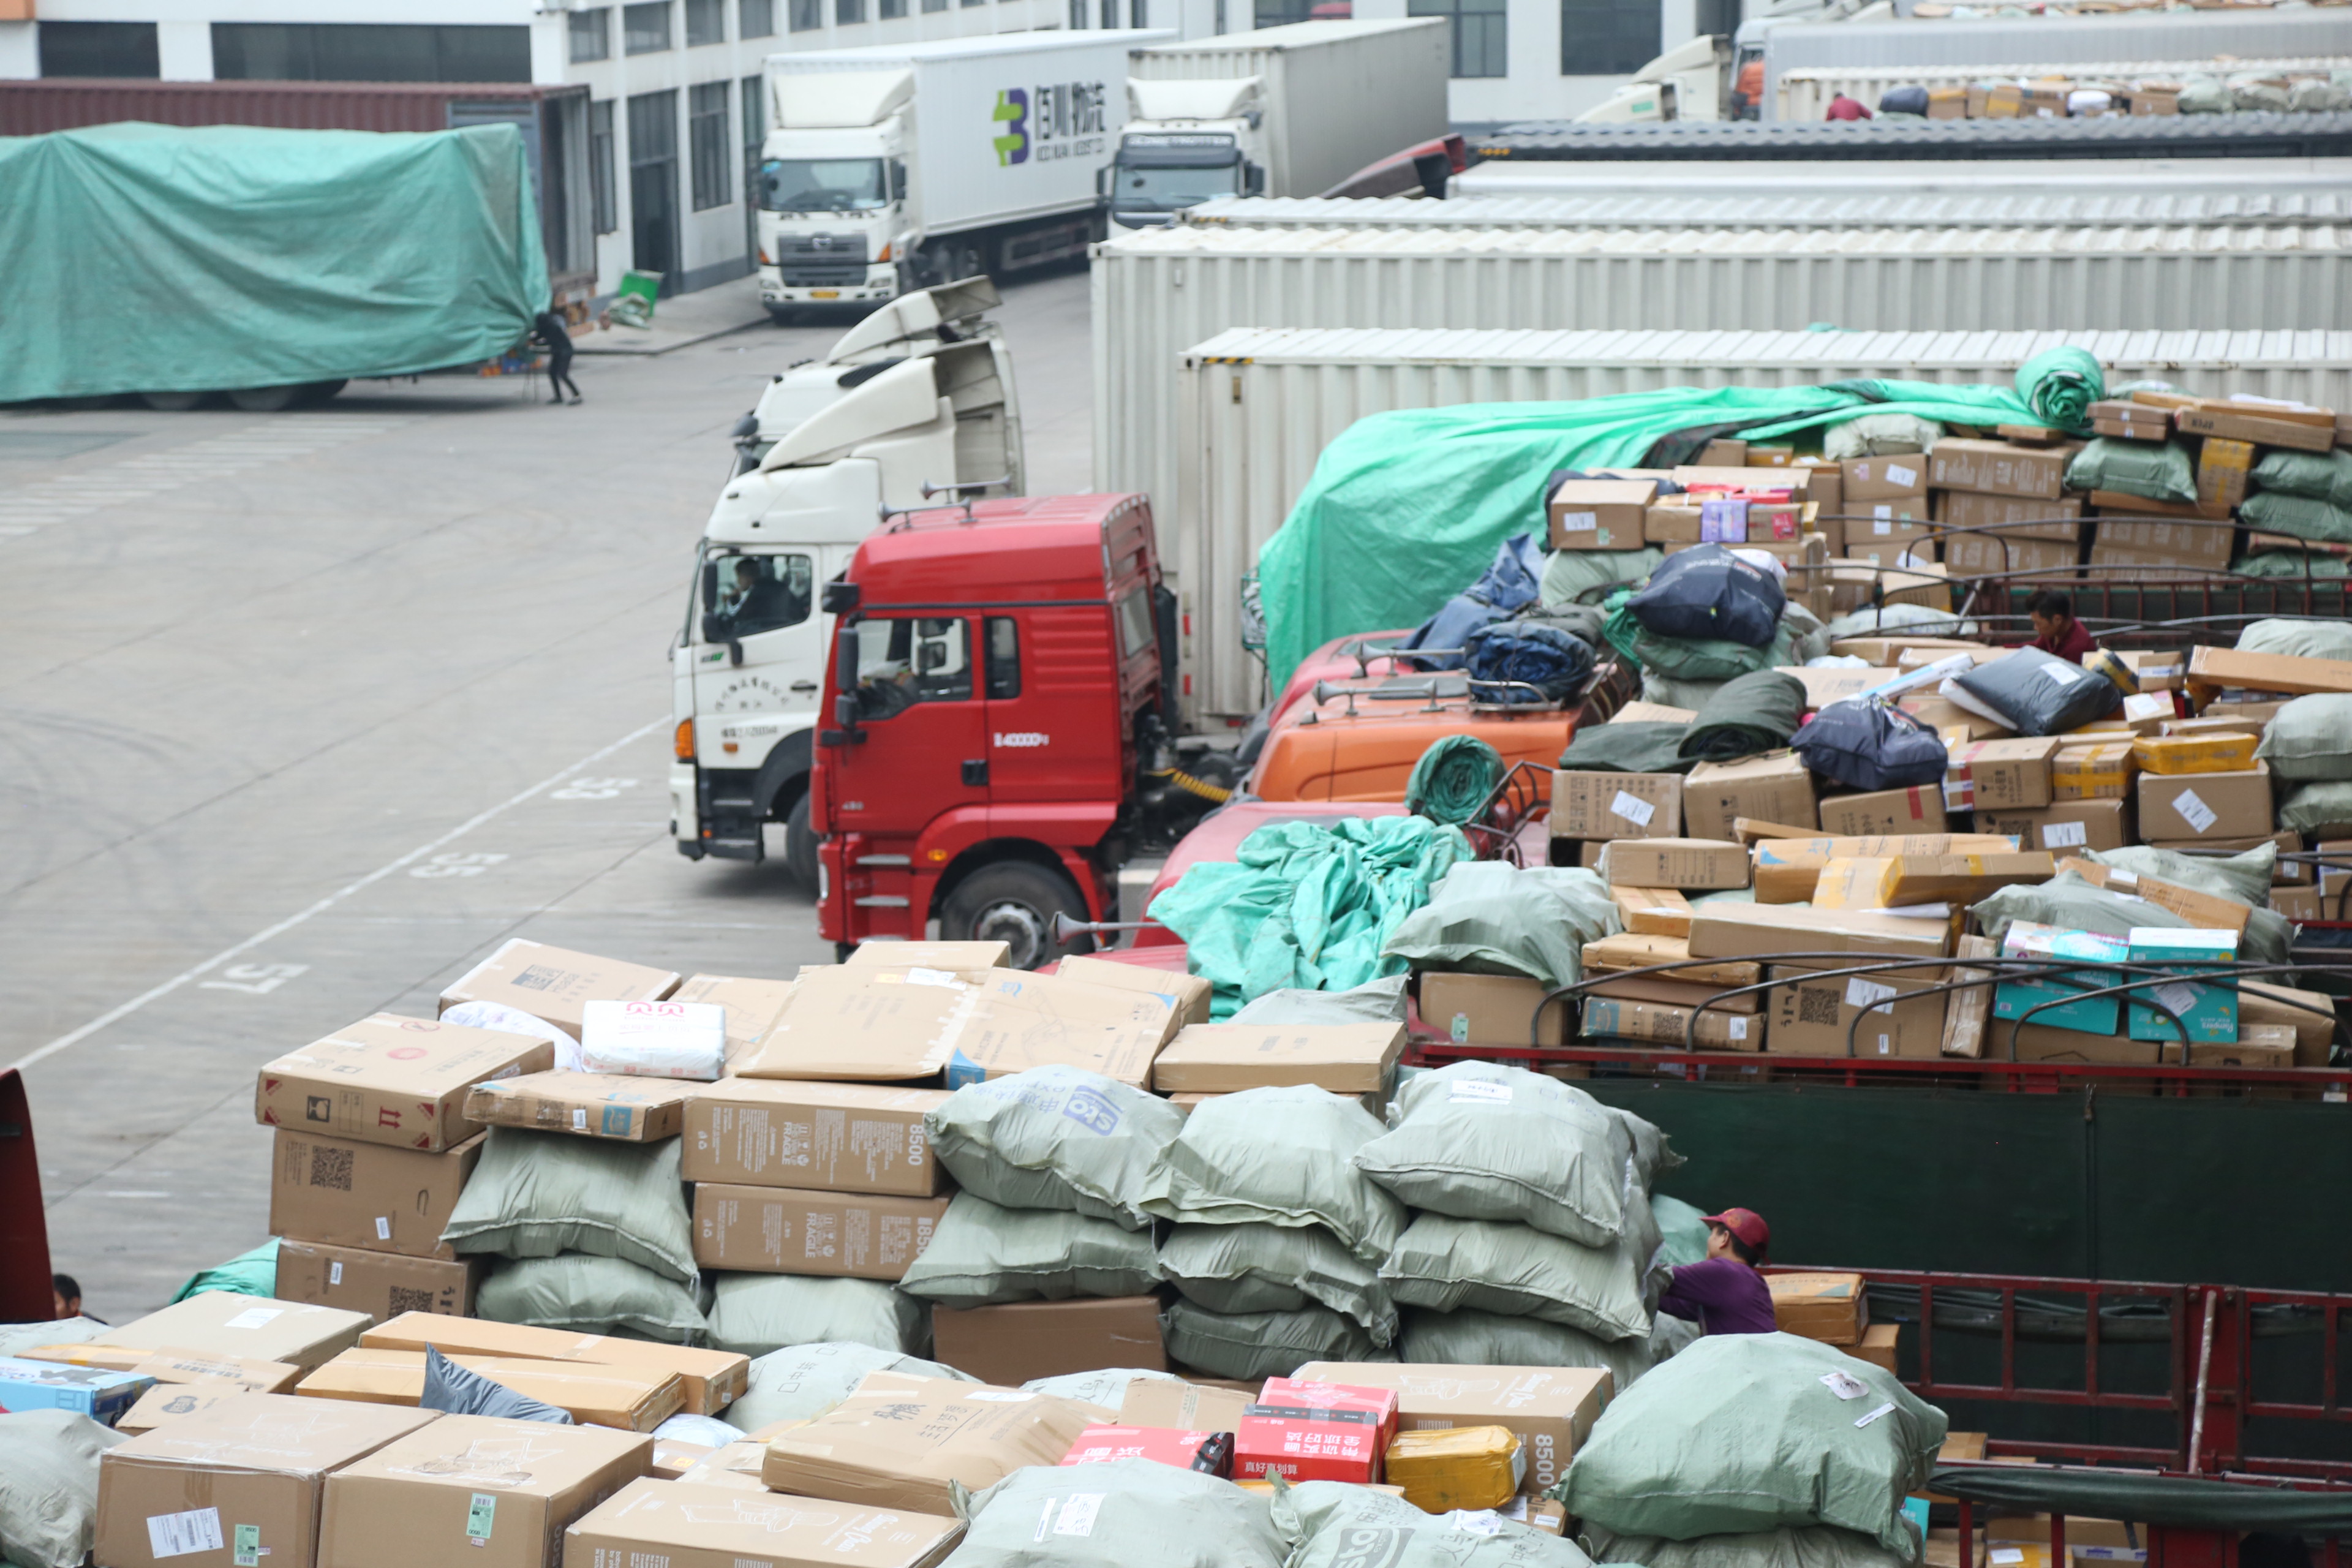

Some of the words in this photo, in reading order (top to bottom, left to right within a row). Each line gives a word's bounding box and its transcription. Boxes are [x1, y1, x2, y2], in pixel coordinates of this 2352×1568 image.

[550, 776, 639, 800] 53
[409, 852, 510, 879] 55
[198, 962, 311, 994] 57
[2201, 1022, 2234, 1033] Pampers
[1068, 1099, 1115, 1131] sto
[782, 1121, 792, 1165] FRAGILE
[908, 1124, 924, 1166] 8500
[805, 1213, 816, 1257] FRAGILE
[1283, 1441, 1359, 1458] 带你买遍
[1286, 1431, 1361, 1447] 全球好货
[1534, 1434, 1555, 1485] 8500
